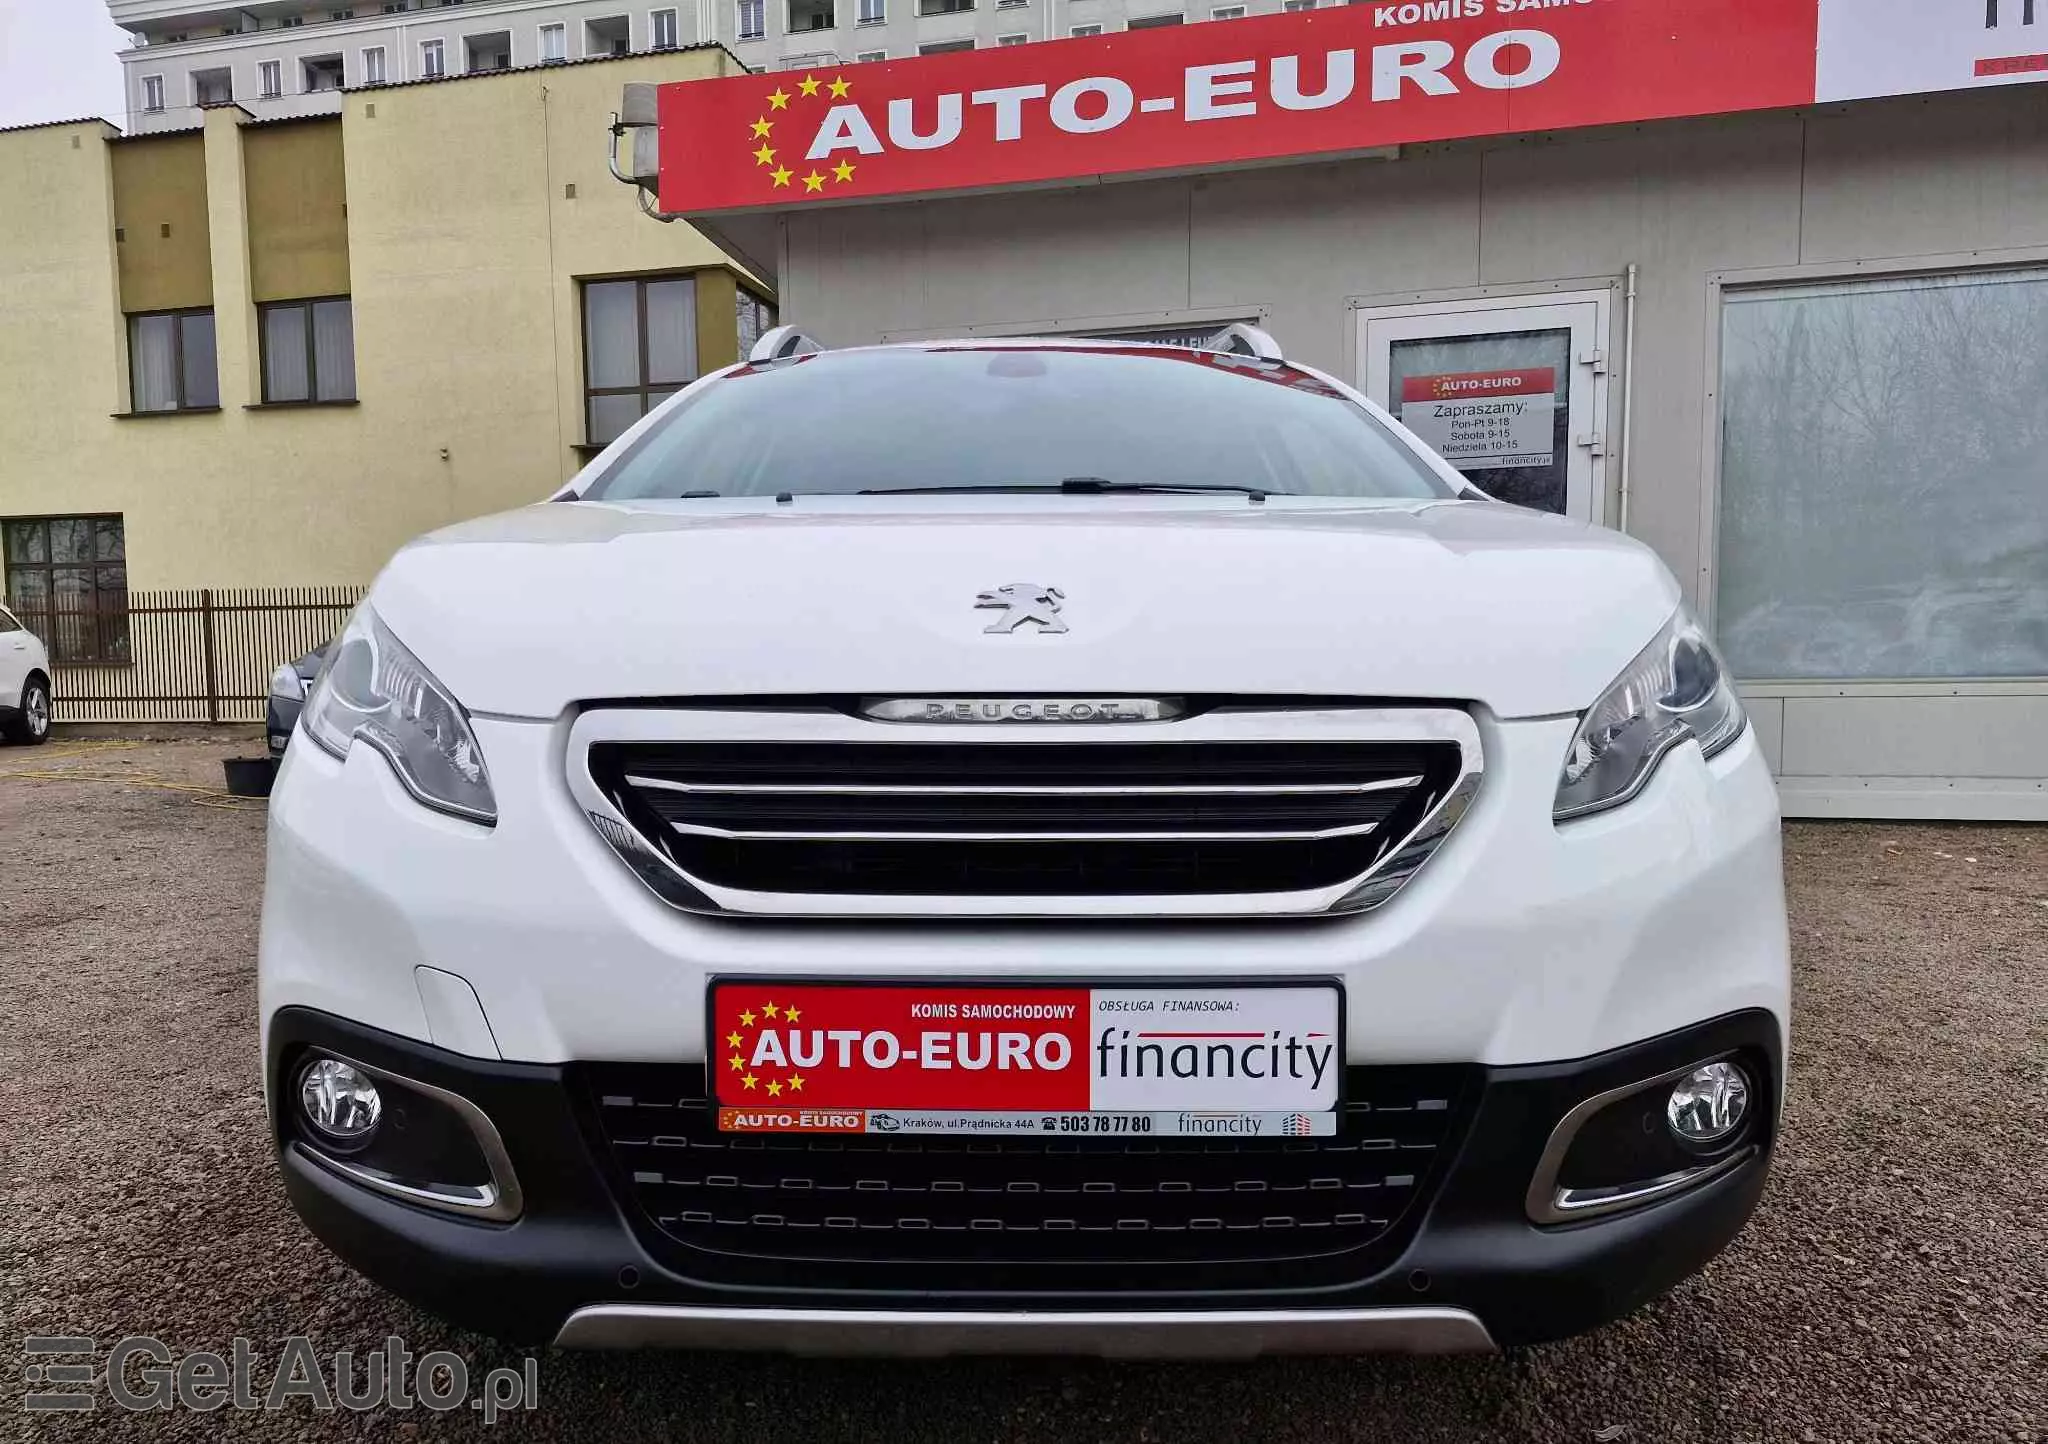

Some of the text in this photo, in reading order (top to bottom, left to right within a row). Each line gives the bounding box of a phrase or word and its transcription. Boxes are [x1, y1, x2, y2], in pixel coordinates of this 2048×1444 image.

[1374, 0, 1484, 28] KOMIS
[805, 29, 1561, 160] AUTO-EURO
[1440, 376, 1522, 391] AUTO-EURO
[1434, 402, 1528, 419] Zapraszamy:
[1451, 417, 1510, 429] Pon-Pt 9-18
[1450, 429, 1510, 441] Sobota 9-15
[1442, 440, 1518, 453] Niedziela 10-15
[926, 703, 1119, 719] PEUGEOT
[911, 1003, 1076, 1019] KOMIS SAMOCHODOWY
[1098, 1000, 1241, 1012] OBSŁUGA FINANSOWA:
[750, 1029, 1073, 1071] AUTO-EURO
[1096, 1027, 1333, 1090] financity
[734, 1114, 859, 1128] AUTO-EURO
[1014, 1118, 1035, 1129] 44A
[1060, 1115, 1151, 1132] 503 78 77 80
[1178, 1112, 1262, 1136] financity
